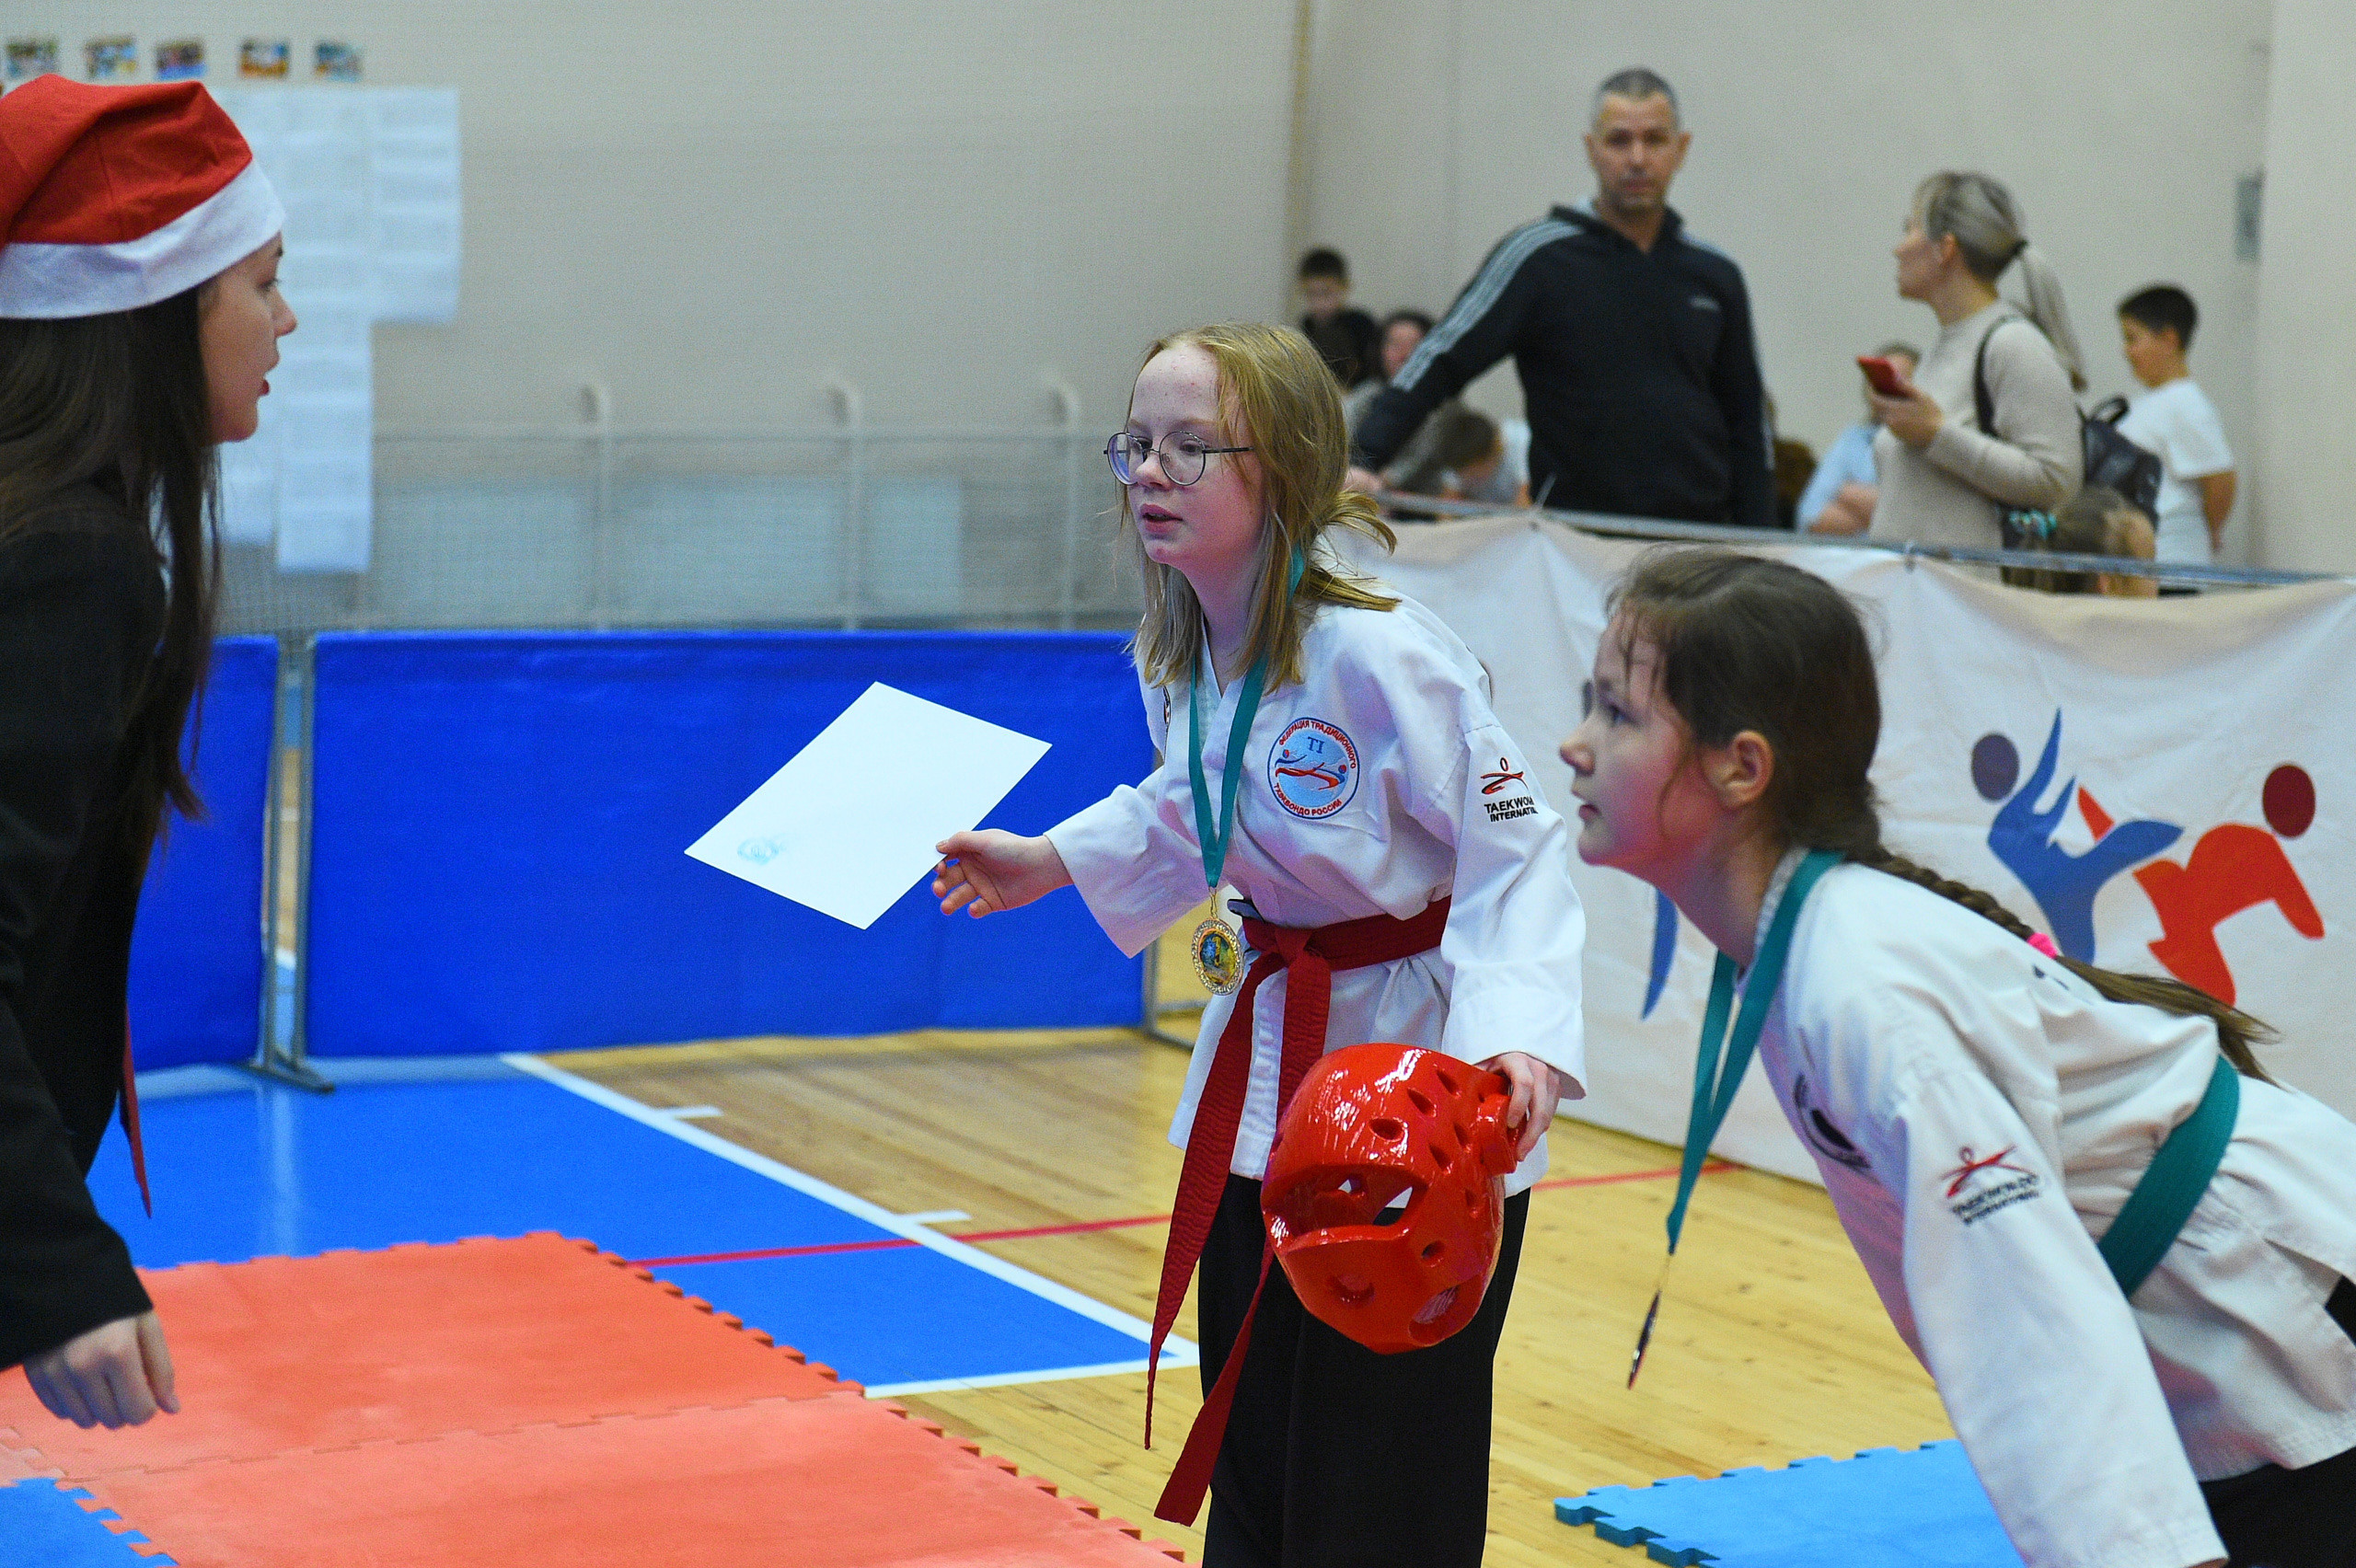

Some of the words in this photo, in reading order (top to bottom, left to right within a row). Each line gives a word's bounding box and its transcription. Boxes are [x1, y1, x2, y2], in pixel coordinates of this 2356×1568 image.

[1311, 721, 1357, 769] ТРАДИЦИОННОГО
[1274, 782, 1311, 816] ТХЭКВОНДО
[1311, 799, 1343, 816] РОССИИ
